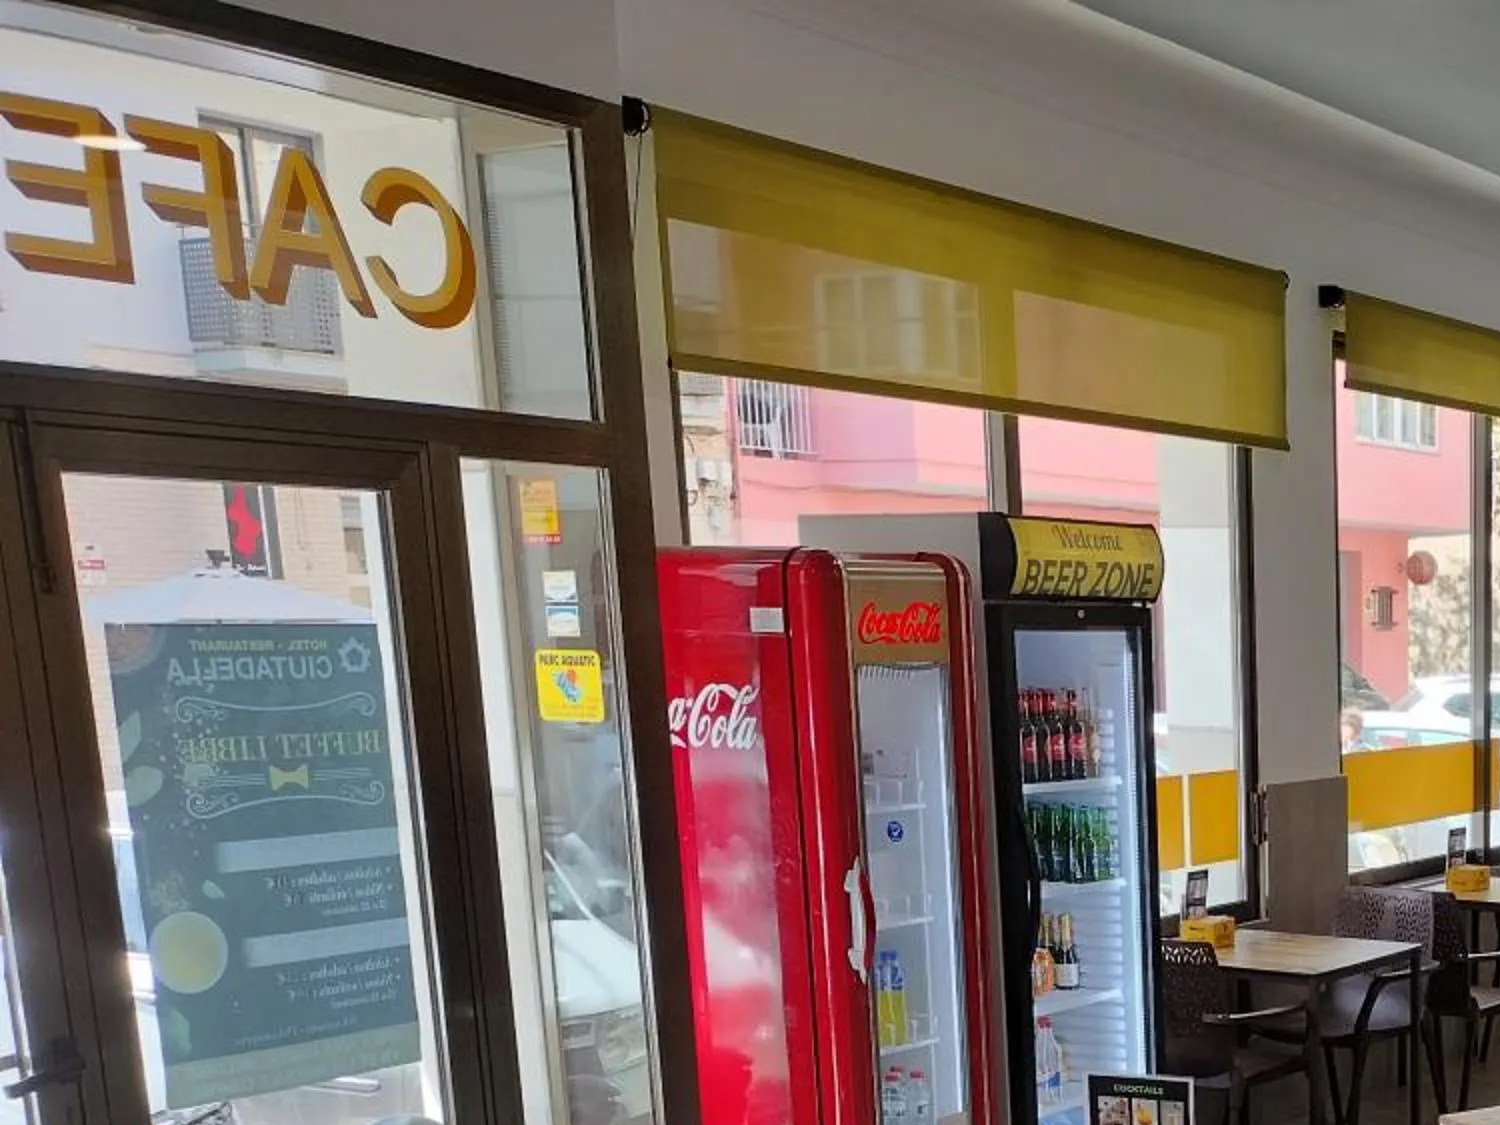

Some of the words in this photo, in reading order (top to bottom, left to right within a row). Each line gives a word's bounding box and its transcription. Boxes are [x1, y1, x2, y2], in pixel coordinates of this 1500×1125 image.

[1051, 524, 1124, 551] Welcome
[1022, 559, 1088, 596] BEER
[1089, 562, 1155, 598] ZONE
